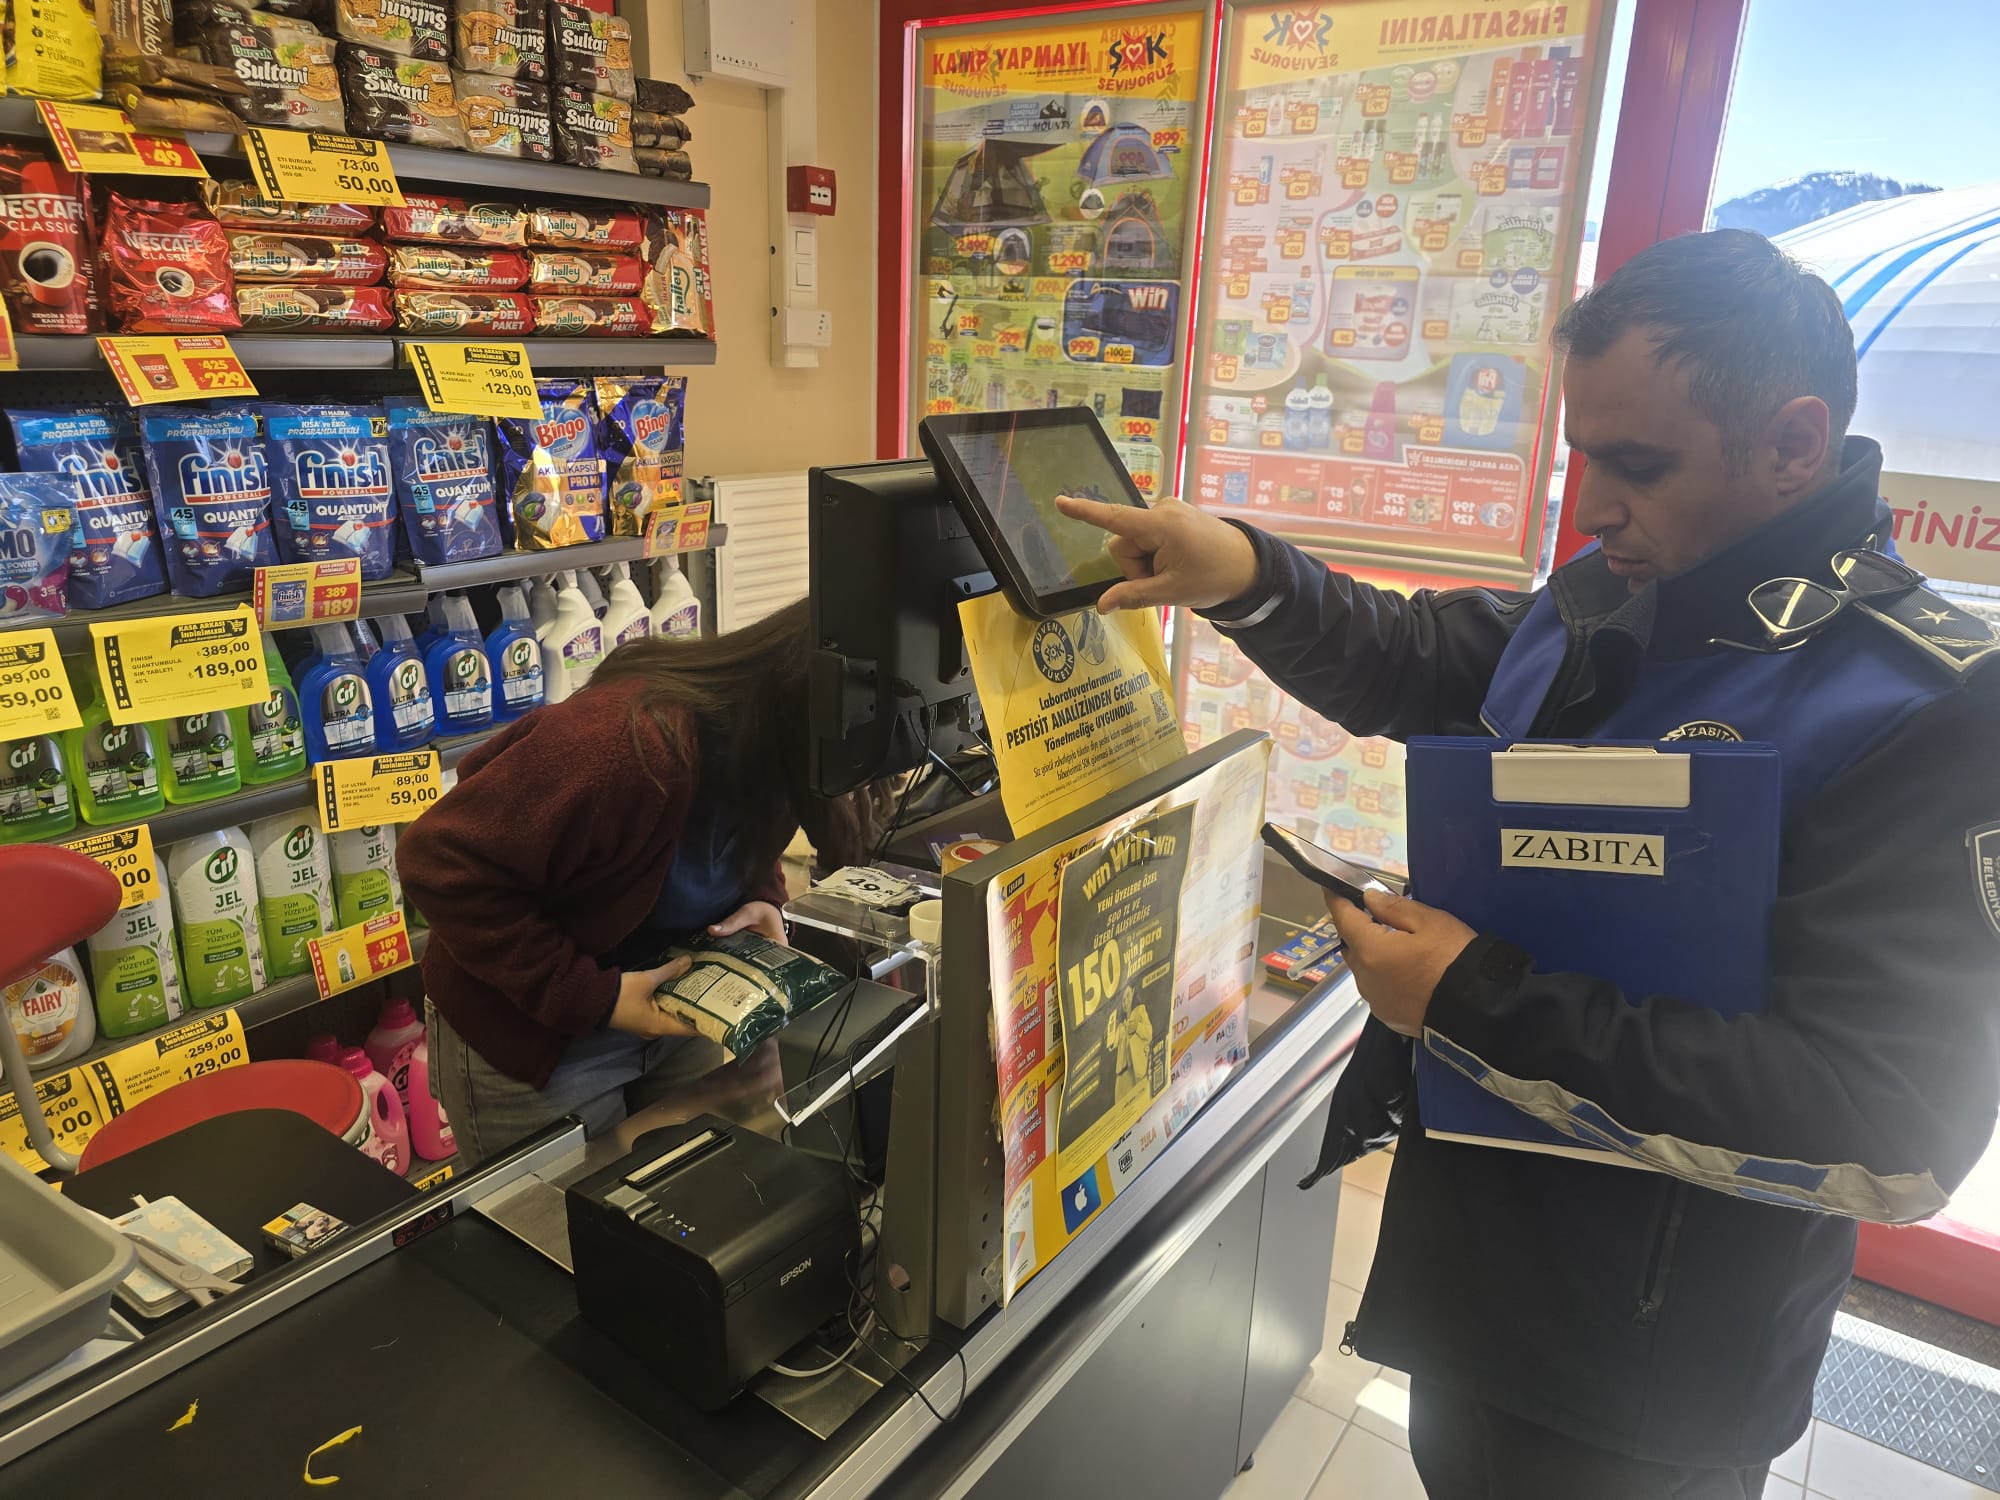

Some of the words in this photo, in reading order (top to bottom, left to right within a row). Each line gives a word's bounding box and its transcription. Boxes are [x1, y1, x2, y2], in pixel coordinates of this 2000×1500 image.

[381, 0, 447, 31] Sultani
[494, 28, 545, 53] Sultani
[933, 49, 988, 75] KAMP
[996, 41, 1087, 71] YAPMAYI
[234, 58, 309, 85] Sultani
[364, 72, 429, 102] Sultani
[493, 110, 550, 135] Sultani
[565, 109, 619, 134] Sultani
[7, 220, 79, 234] CLASSIC
[331, 218, 363, 226] PAKET
[548, 218, 577, 238] halley
[250, 250, 291, 275] halley
[417, 258, 451, 278] halley
[334, 270, 373, 279] PAKET
[491, 277, 518, 285] PAKET
[552, 264, 580, 284] halley
[672, 265, 691, 315] halley
[262, 301, 303, 321] halley
[500, 310, 520, 319] DEV
[619, 314, 636, 323] DEV
[492, 320, 525, 330] PAKET
[612, 324, 639, 332] PAKET
[205, 372, 245, 387] 229
[536, 416, 585, 448] Bingo
[636, 412, 669, 441] Bingo
[296, 450, 390, 489] finish
[537, 465, 567, 476] AKILLI
[322, 488, 374, 496] POWERBALL
[413, 486, 429, 495] 45
[435, 482, 491, 498] QUANTUM
[570, 477, 587, 487] PRO
[210, 492, 262, 502] POWERBALL
[290, 502, 307, 511] 45
[173, 508, 194, 519] 45
[316, 502, 386, 517] QUANTUM
[326, 587, 347, 598] 389
[323, 598, 353, 615] 189
[1033, 620, 1068, 653] GÜVENLE
[514, 644, 530, 664] Cif
[457, 656, 475, 676] Cif
[503, 669, 526, 678] ULTRA
[1041, 653, 1074, 682] TÜKETİN
[401, 665, 416, 689] Cif
[336, 682, 355, 704] Cif
[392, 693, 415, 704] ULTRA
[1039, 666, 1123, 711] Laboratuvarlarımızda
[263, 692, 282, 716] Cif
[186, 713, 208, 734] Cif
[252, 722, 280, 733] ULTRA
[1006, 714, 1050, 749] PESTİSİT
[1052, 689, 1112, 730] ANALİZİNDEN
[103, 727, 128, 751] Cif
[1044, 720, 1095, 753] Yönetmeliğe
[1687, 726, 1736, 743] ZABITA
[10, 742, 37, 769] Cif
[287, 828, 311, 858] Cif
[1511, 834, 1659, 868] ZABITA
[209, 850, 235, 882] Cif
[292, 866, 318, 883] JEL
[215, 890, 243, 908] JEL
[1097, 892, 1113, 913] YENİ
[1114, 880, 1142, 904] ÜYELERE
[127, 915, 157, 934] JEL
[206, 928, 223, 936] TÜM
[206, 931, 240, 943] YÜZEYLER
[380, 937, 397, 950] 189
[378, 949, 399, 968] 99
[1068, 939, 1121, 1028] 150
[23, 990, 62, 1018] FAIRY
[780, 1257, 812, 1288] EPSON
